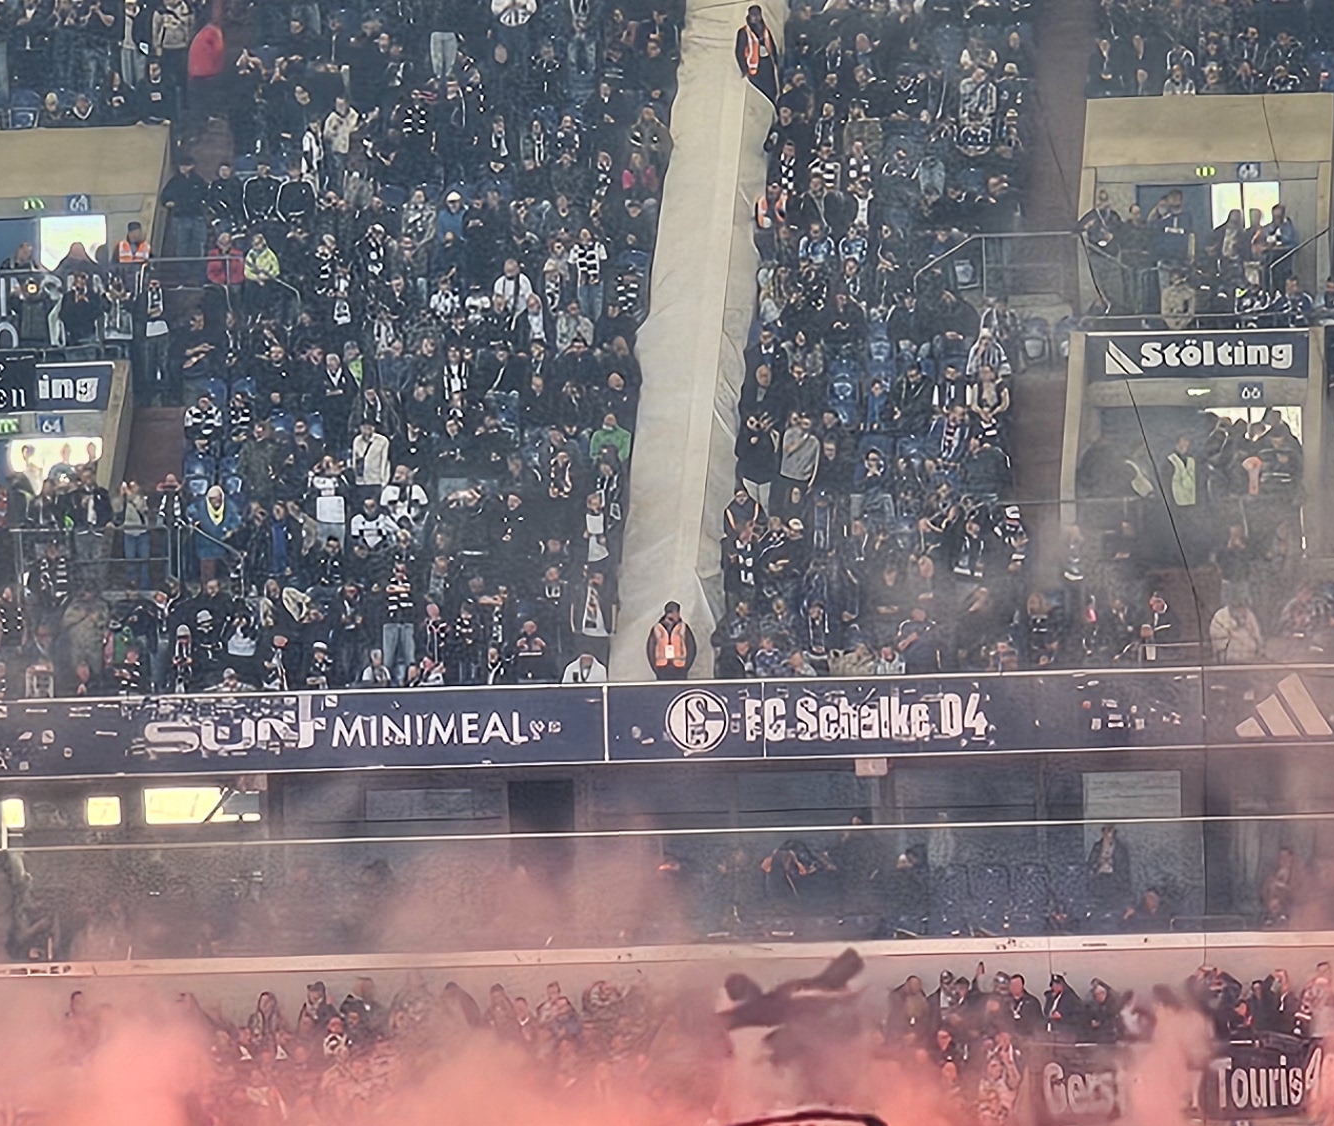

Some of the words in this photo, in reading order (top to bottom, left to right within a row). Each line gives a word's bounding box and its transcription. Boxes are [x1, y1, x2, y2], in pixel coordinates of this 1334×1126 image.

[1140, 338, 1293, 369] Stölting
[331, 710, 530, 749] MINIMEAL
[744, 698, 787, 742] FC
[794, 695, 931, 742] Schalke
[941, 692, 991, 740] 04
